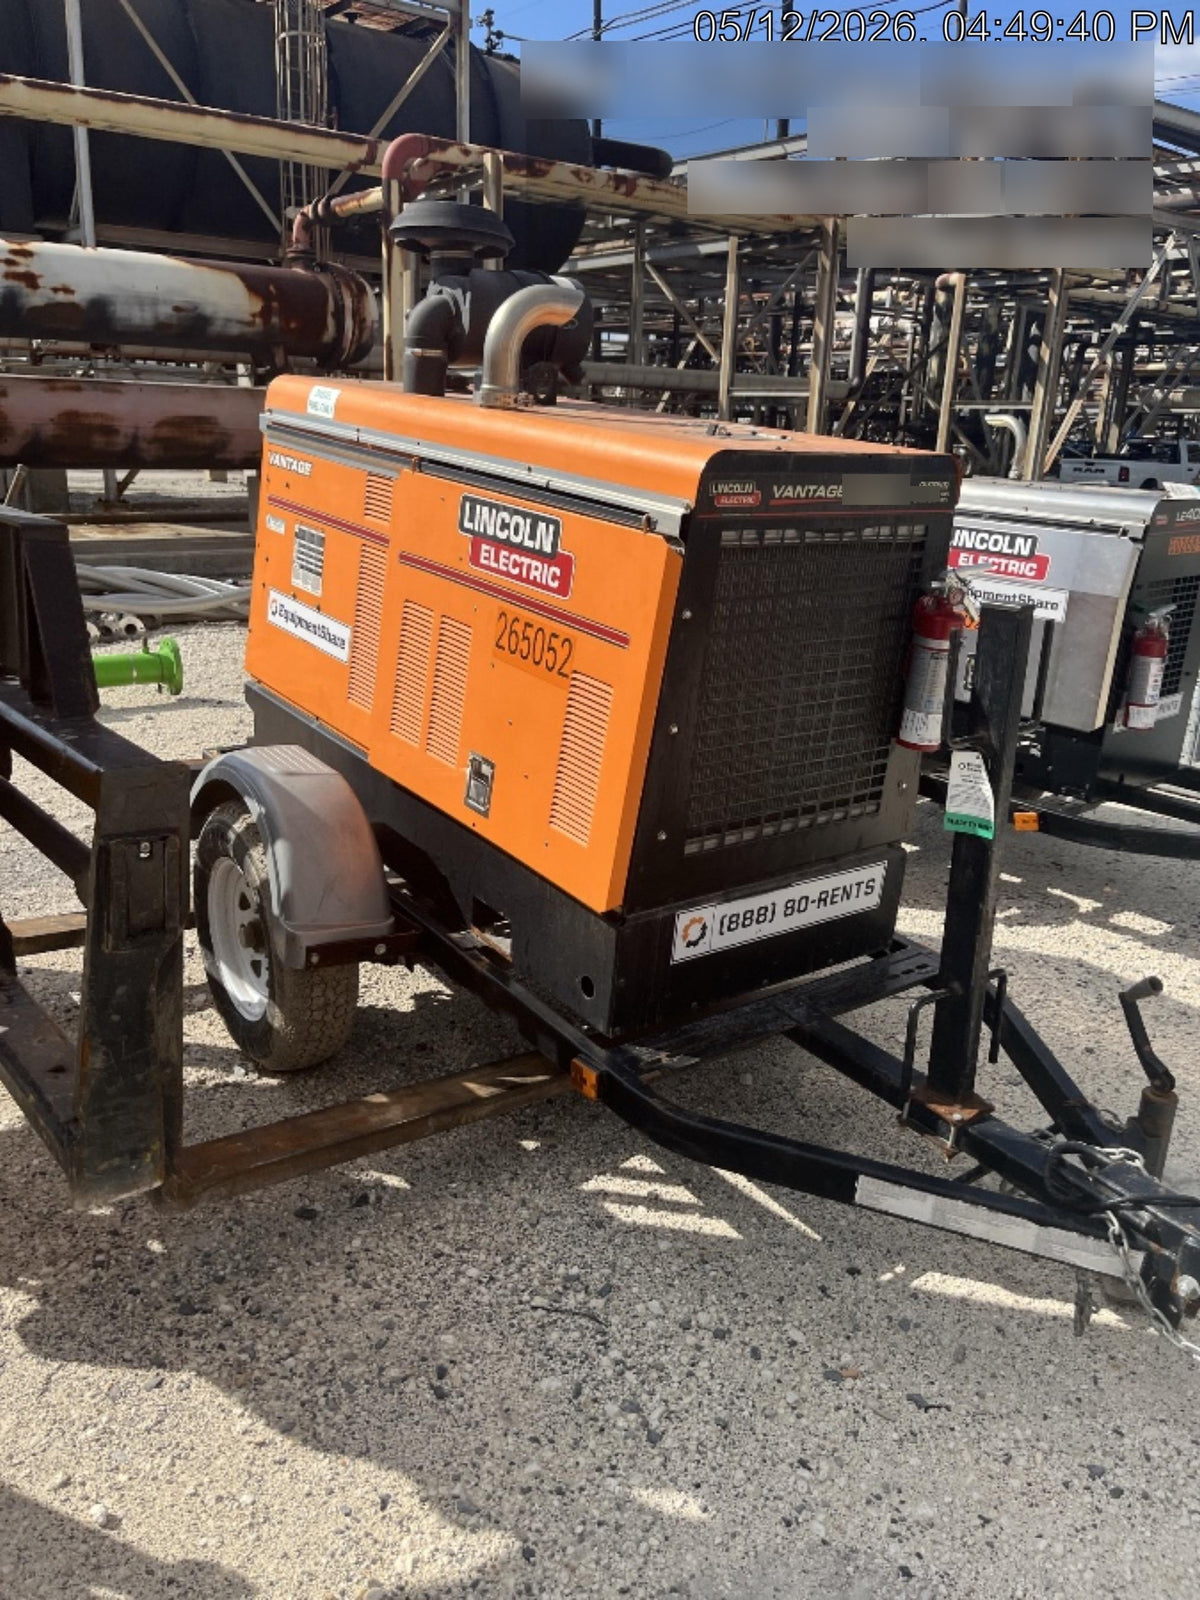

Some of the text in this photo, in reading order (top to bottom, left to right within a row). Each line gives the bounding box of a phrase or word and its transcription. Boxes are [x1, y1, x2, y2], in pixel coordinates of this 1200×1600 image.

[267, 451, 313, 475] VANTAGE
[712, 481, 753, 494] LINCOLN
[463, 500, 558, 553] LINCOLN
[952, 529, 1033, 557] INCOLN
[479, 543, 561, 588] ELECTRIC
[278, 602, 346, 650] EquipmentShare
[495, 610, 574, 679] 265052
[719, 878, 877, 936] (888) 80-RENTS
